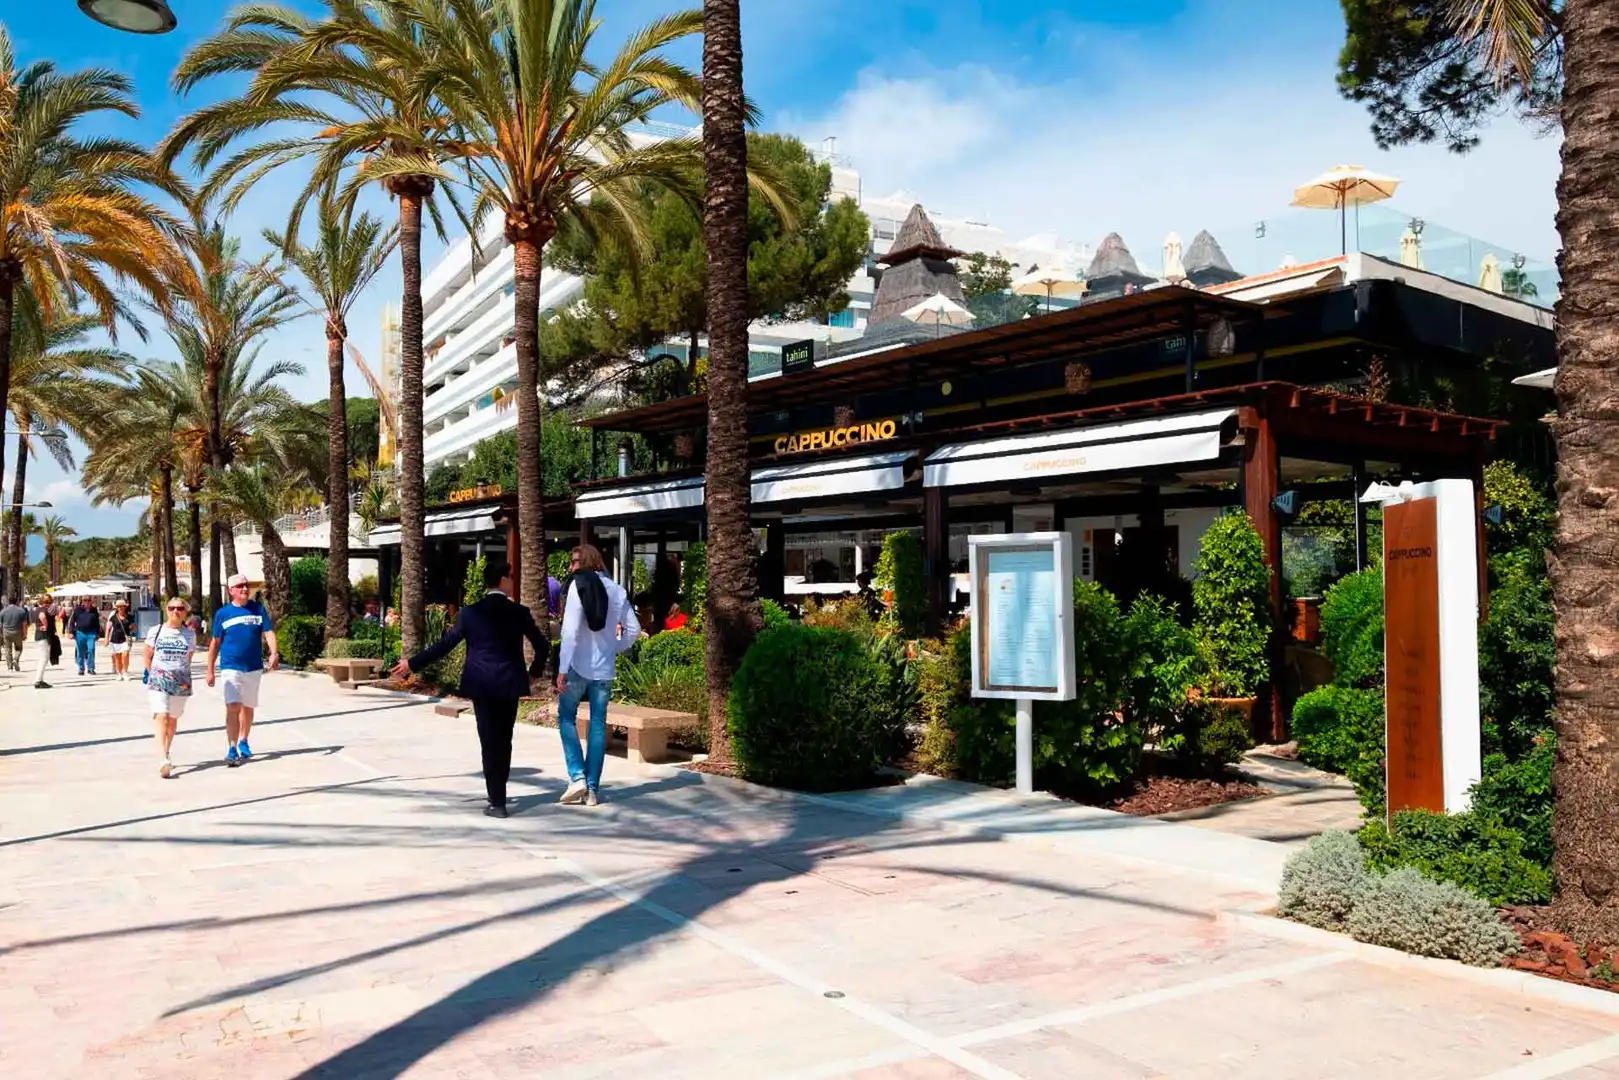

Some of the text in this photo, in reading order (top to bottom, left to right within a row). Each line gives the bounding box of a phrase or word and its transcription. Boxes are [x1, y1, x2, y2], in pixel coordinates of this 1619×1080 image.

[786, 346, 808, 362] tahini
[774, 419, 896, 453] CAPPUCCINO
[1388, 546, 1432, 560] CAPPUCCINO
